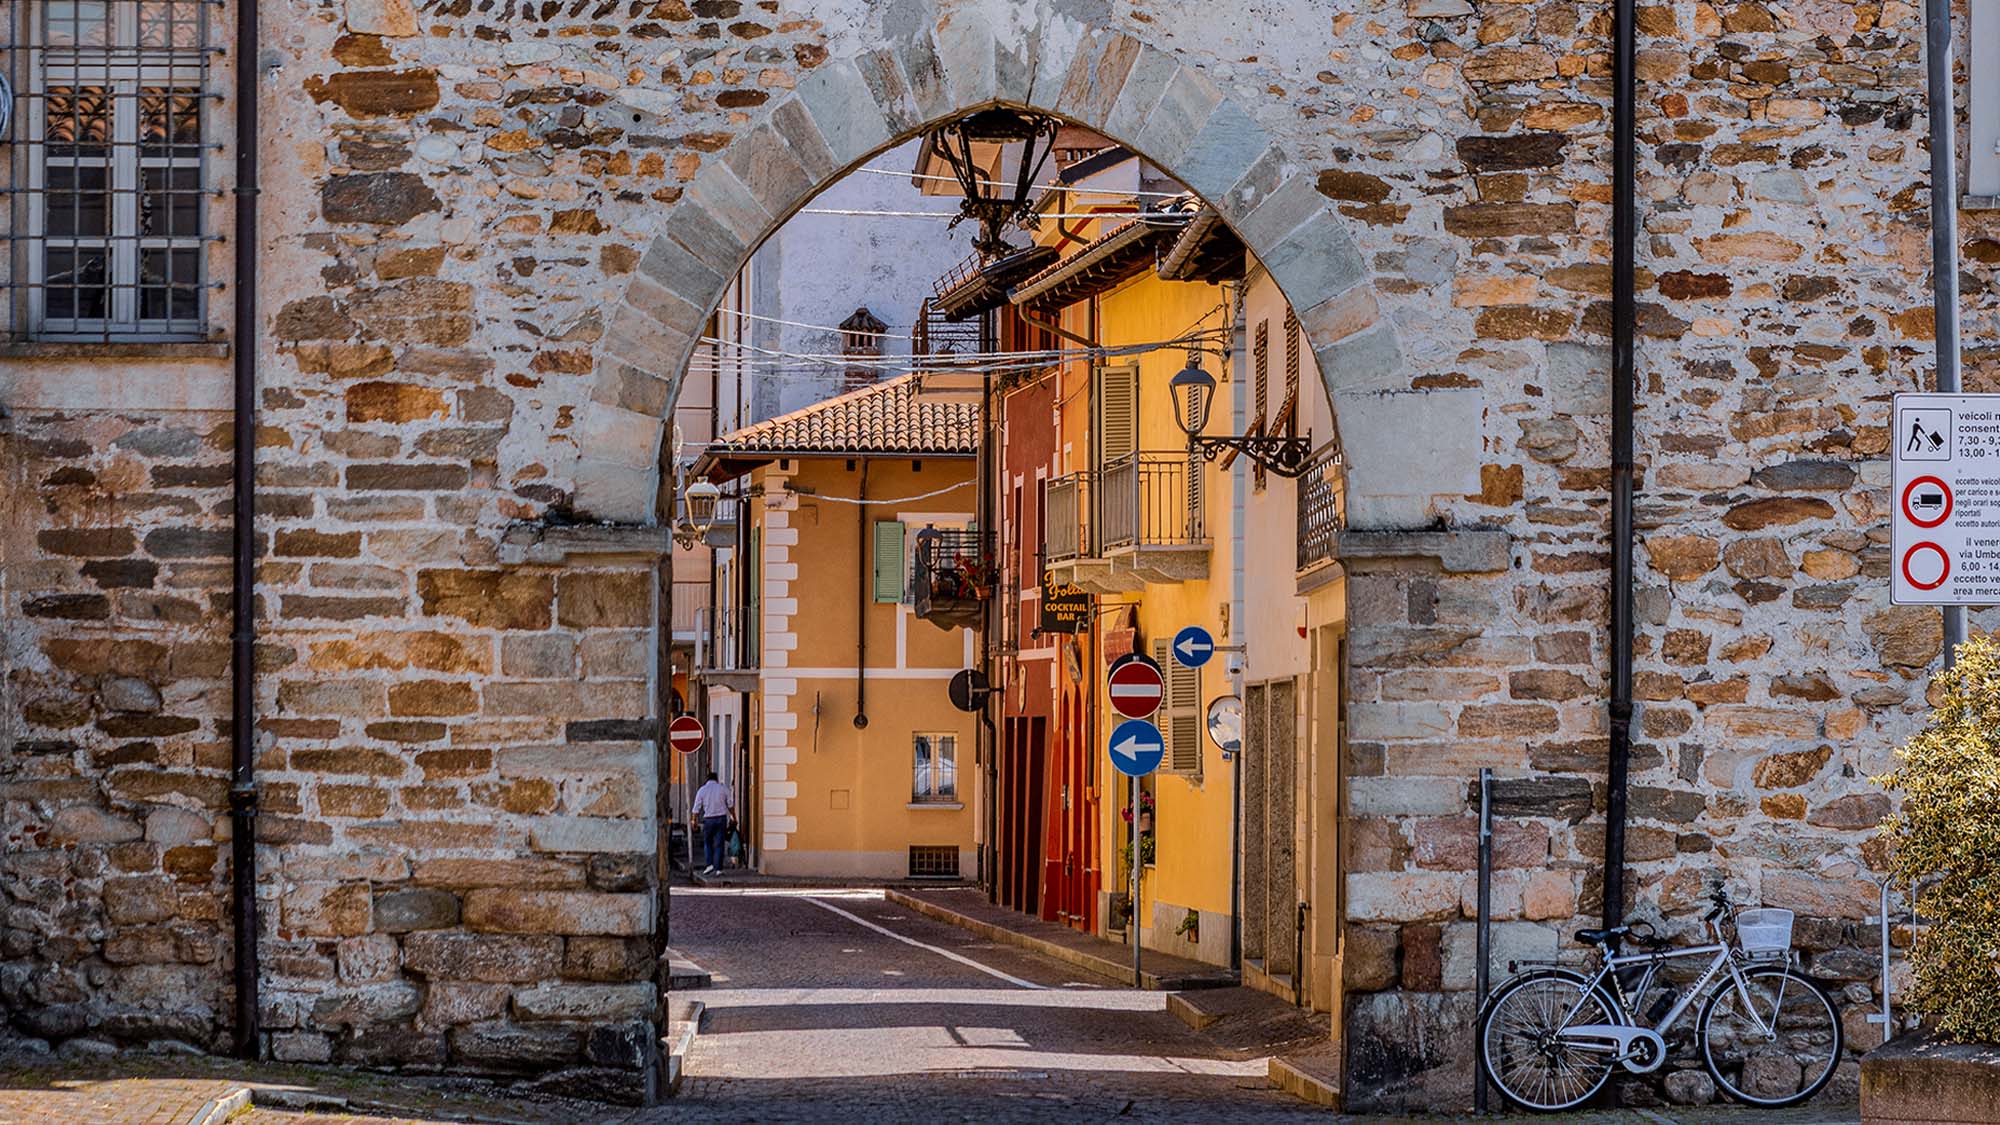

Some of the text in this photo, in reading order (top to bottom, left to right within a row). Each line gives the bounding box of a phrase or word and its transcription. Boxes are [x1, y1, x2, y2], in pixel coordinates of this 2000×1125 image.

[1959, 411, 1992, 420] veicoli
[1959, 425, 2000, 433] consent
[1959, 435, 1980, 446] 7,30
[1959, 448, 1985, 458] 13,00
[1959, 550, 1972, 558] via
[1961, 561, 1980, 572] 6,00
[1953, 575, 1987, 583] eccetto
[1953, 587, 1973, 595] area
[1044, 603, 1087, 612] COCKTAIL
[1056, 612, 1075, 621] BAR
